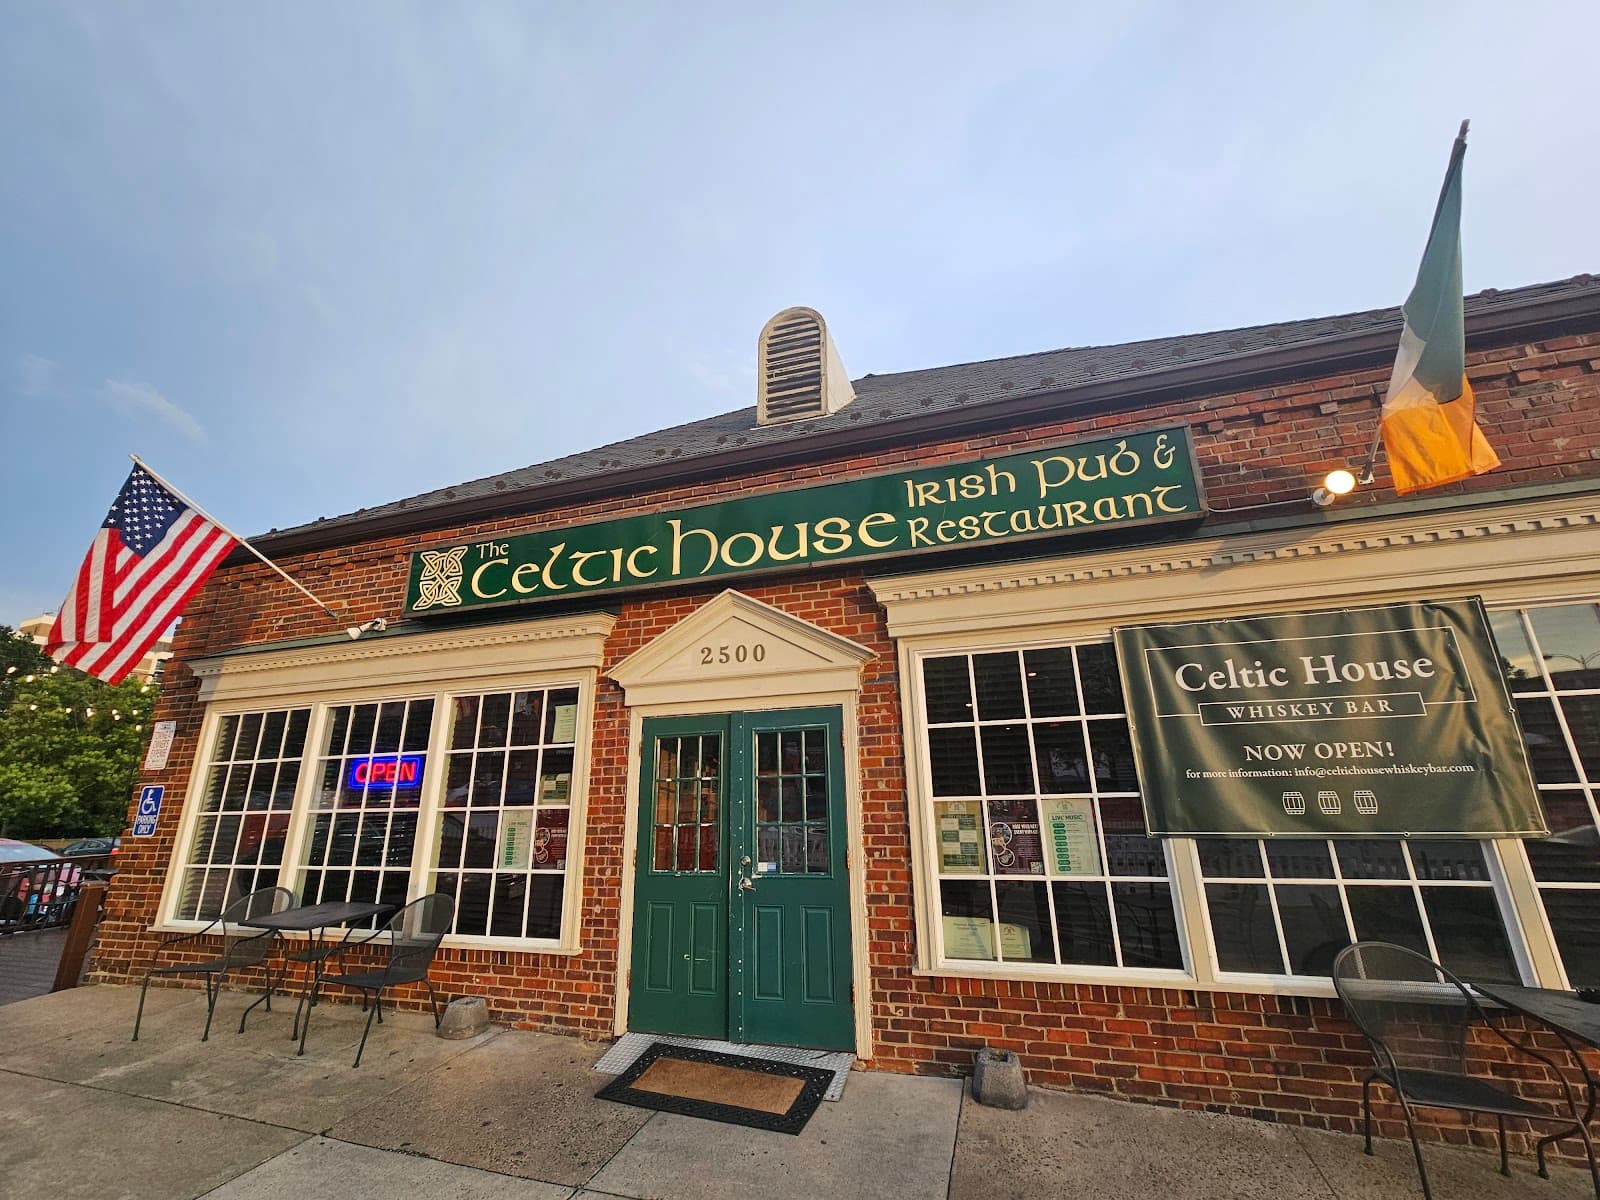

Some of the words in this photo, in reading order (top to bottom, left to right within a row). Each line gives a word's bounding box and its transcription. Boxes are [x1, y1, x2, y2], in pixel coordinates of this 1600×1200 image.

[1031, 440, 1140, 498] Pub
[1153, 434, 1176, 469] &
[909, 484, 1188, 548] Restaurant
[476, 541, 510, 559] The
[471, 542, 658, 599] Celtic
[701, 644, 766, 665] 2500
[1175, 658, 1289, 692] Celtic
[1299, 654, 1435, 685] House
[1226, 702, 1334, 719] WHISKEY
[1345, 699, 1394, 714] BAR
[1243, 743, 1307, 761] NOW
[1314, 740, 1395, 760] OPEN!
[355, 761, 417, 783] OPEN
[1186, 768, 1201, 779] for
[1202, 769, 1227, 778] more
[1229, 767, 1293, 778] information:
[1294, 762, 1475, 779] info@celtichousewhiskeybar.com
